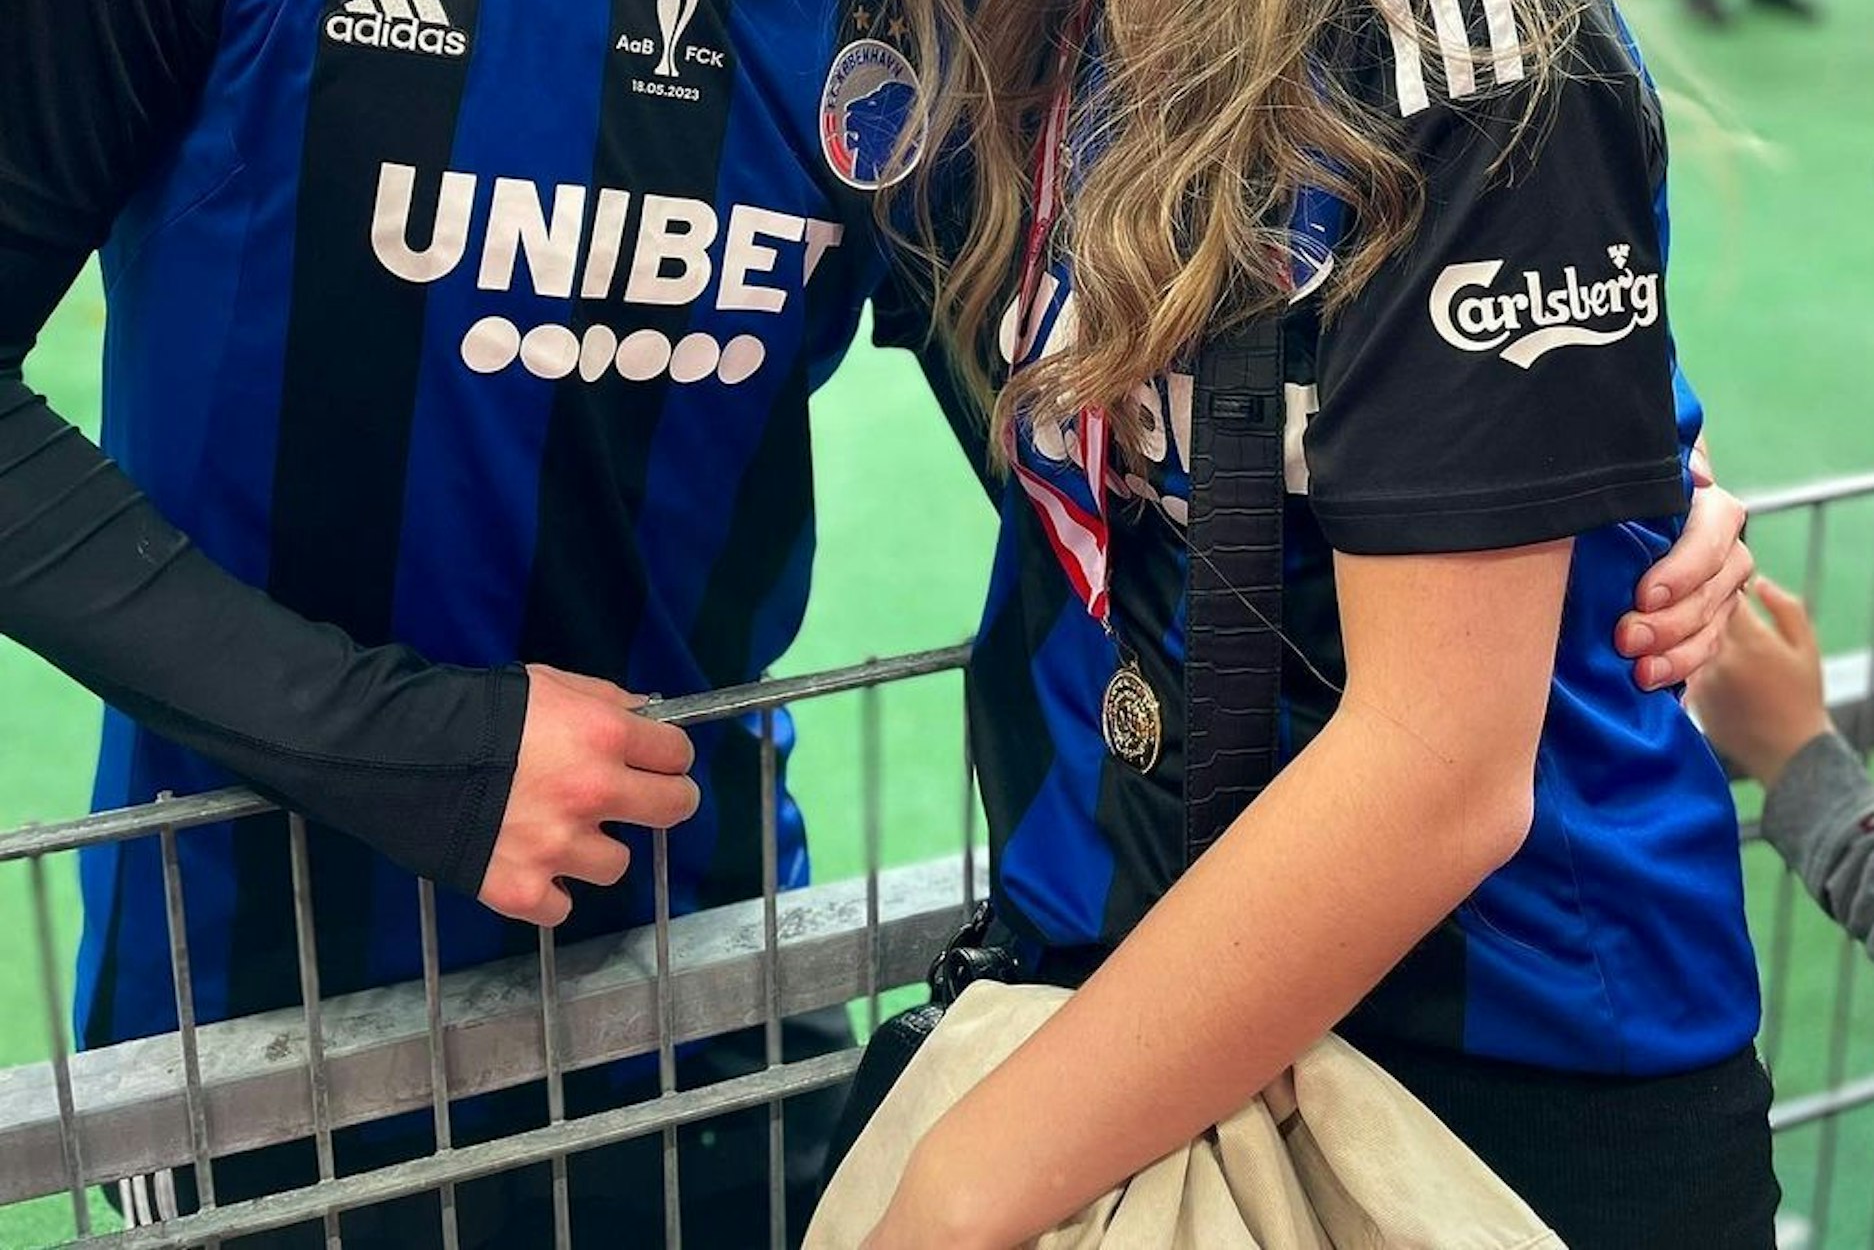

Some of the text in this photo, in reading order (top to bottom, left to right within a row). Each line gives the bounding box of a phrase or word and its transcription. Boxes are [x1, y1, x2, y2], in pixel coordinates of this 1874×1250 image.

[326, 15, 466, 55] adidas
[616, 34, 725, 68] AaB FCK
[632, 79, 700, 102] 18.05.2023
[1429, 259, 1659, 352] Carlsberg
